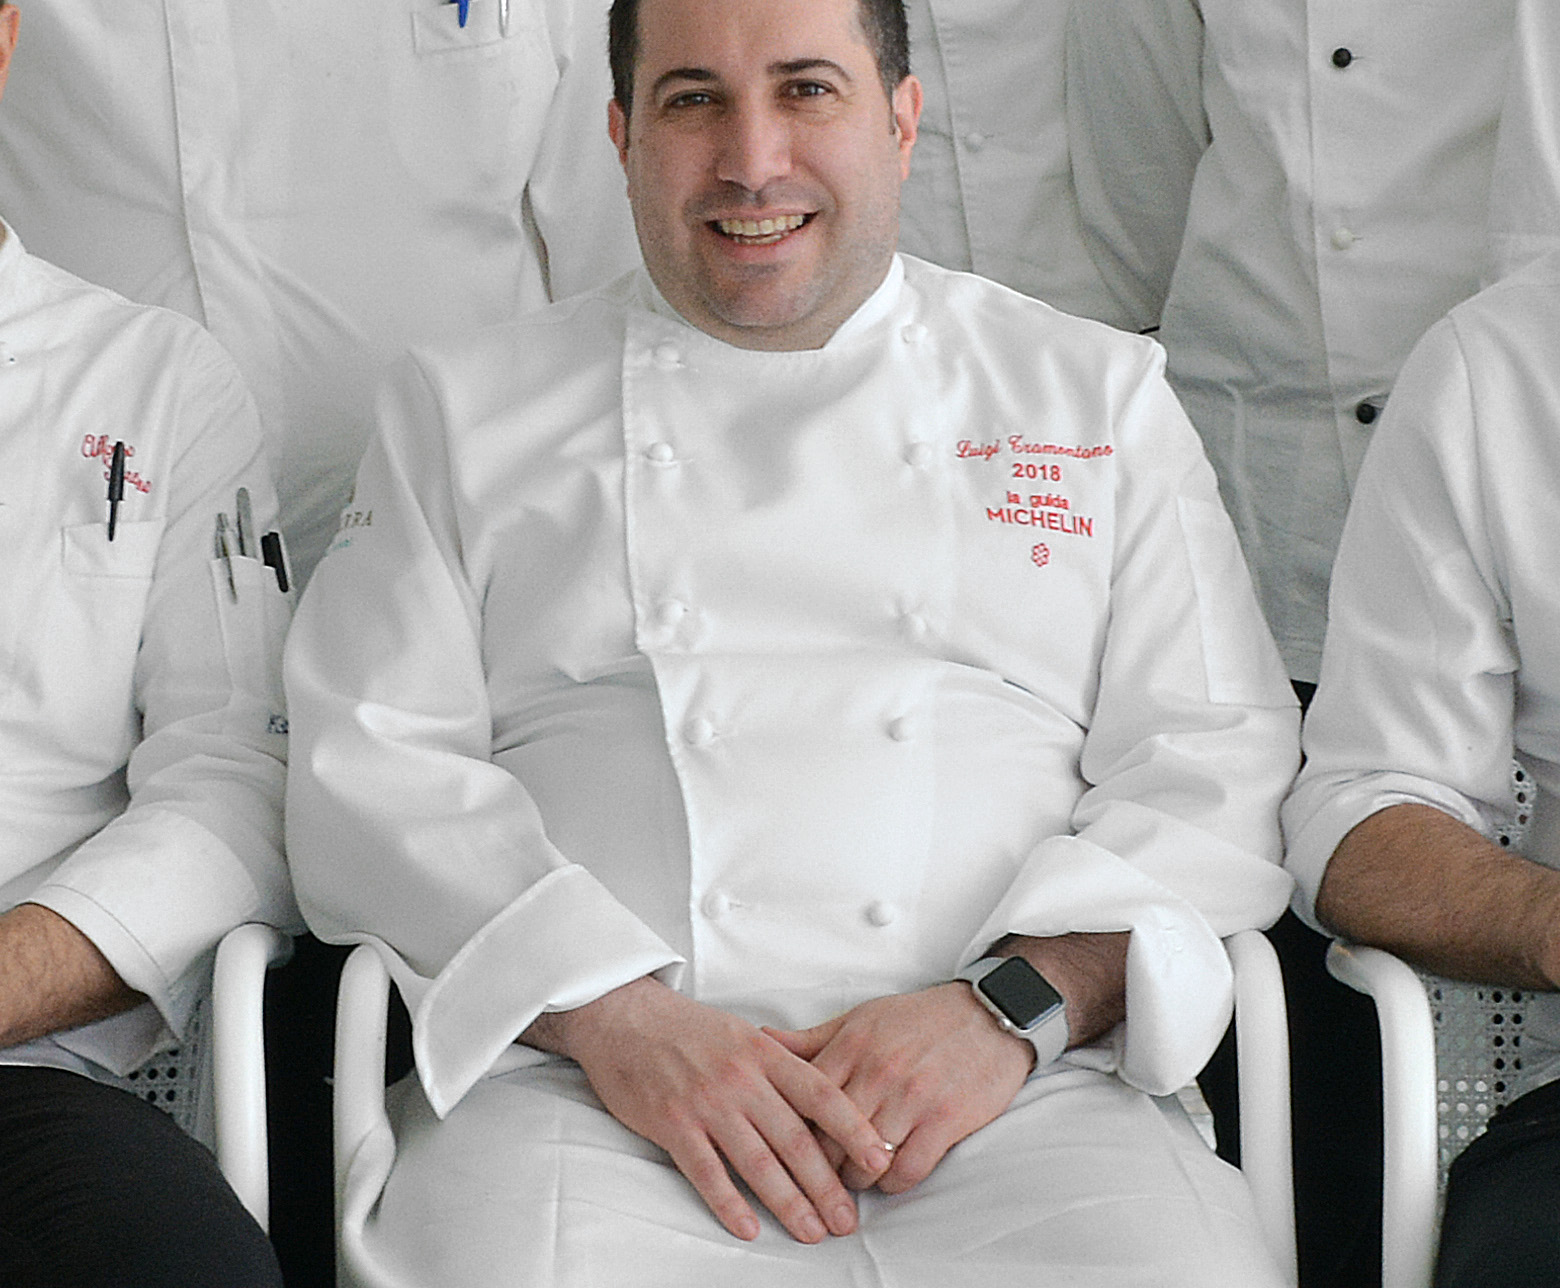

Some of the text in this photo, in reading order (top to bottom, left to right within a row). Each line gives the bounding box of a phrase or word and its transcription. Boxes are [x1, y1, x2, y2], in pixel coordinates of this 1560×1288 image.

[956, 434, 1114, 461] Luigi Tramontano
[1012, 463, 1063, 482] 2018
[1006, 490, 1071, 510] la guida
[986, 508, 1094, 538] MICHELIN
